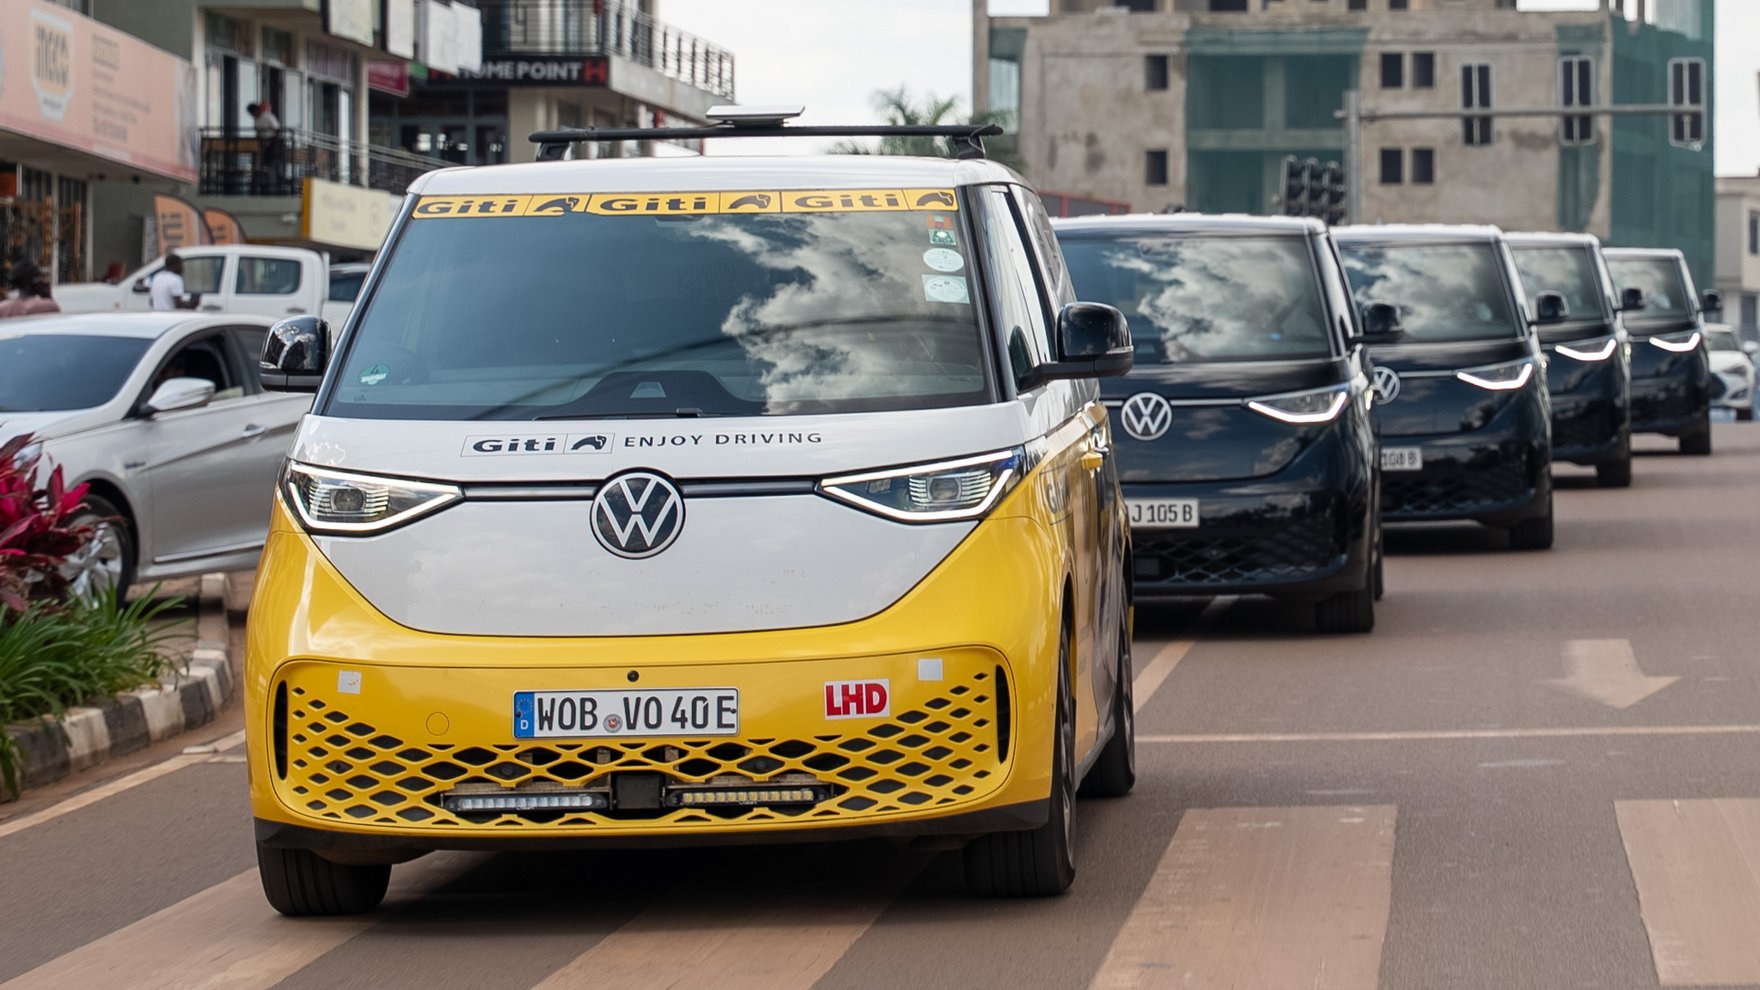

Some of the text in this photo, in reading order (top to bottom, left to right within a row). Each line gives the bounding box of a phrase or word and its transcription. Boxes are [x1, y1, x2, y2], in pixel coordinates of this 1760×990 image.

[417, 193, 900, 214] Giti Giti Giti
[472, 432, 822, 452] Giti ENJOY DRIVING
[595, 472, 682, 553] VW
[1147, 504, 1178, 523] 105
[1183, 504, 1193, 522] B
[825, 682, 887, 717] LHD
[537, 697, 598, 731] WOB
[623, 696, 662, 730] VO
[520, 720, 529, 730] D
